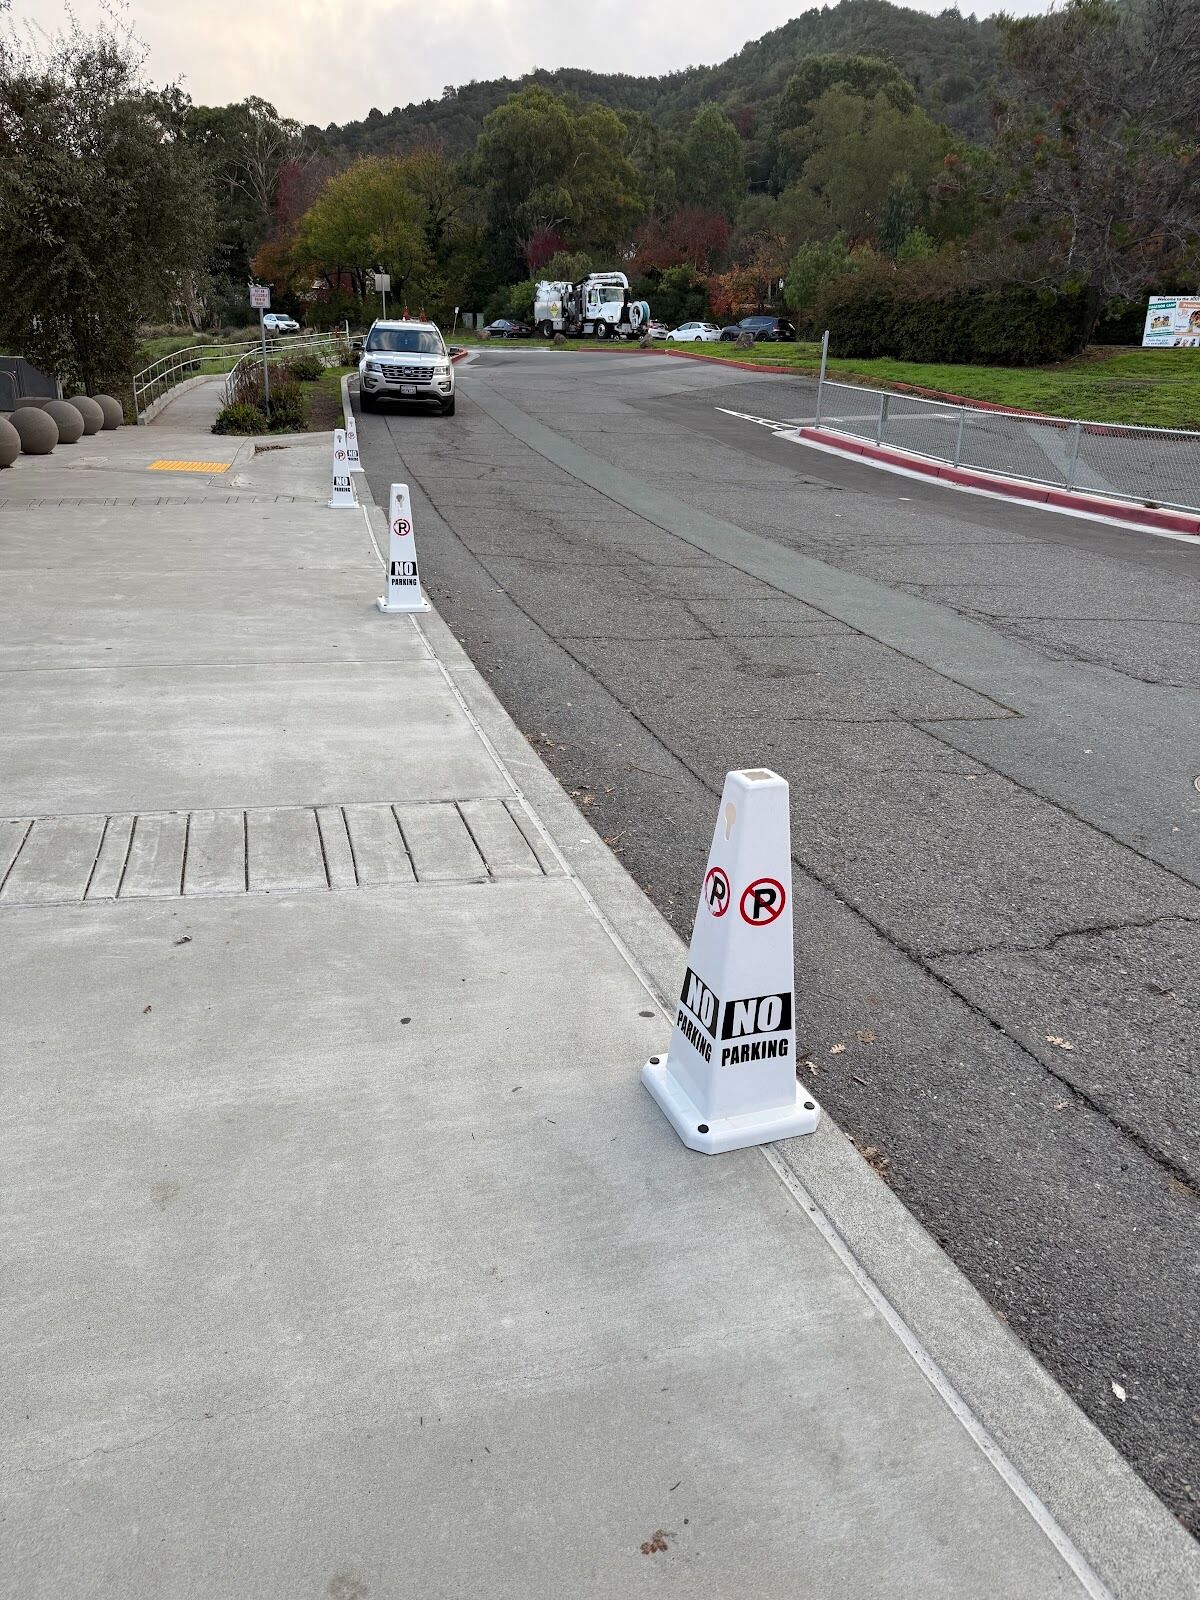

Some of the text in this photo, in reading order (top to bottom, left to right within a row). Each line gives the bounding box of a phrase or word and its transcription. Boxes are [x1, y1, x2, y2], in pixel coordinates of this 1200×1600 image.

[335, 477, 349, 486] NO
[391, 578, 417, 586] PARKING
[394, 561, 414, 576] NO
[686, 972, 715, 1029] NO
[731, 995, 783, 1037] NO
[676, 1009, 712, 1064] PARKING
[721, 1038, 789, 1067] PARKING
